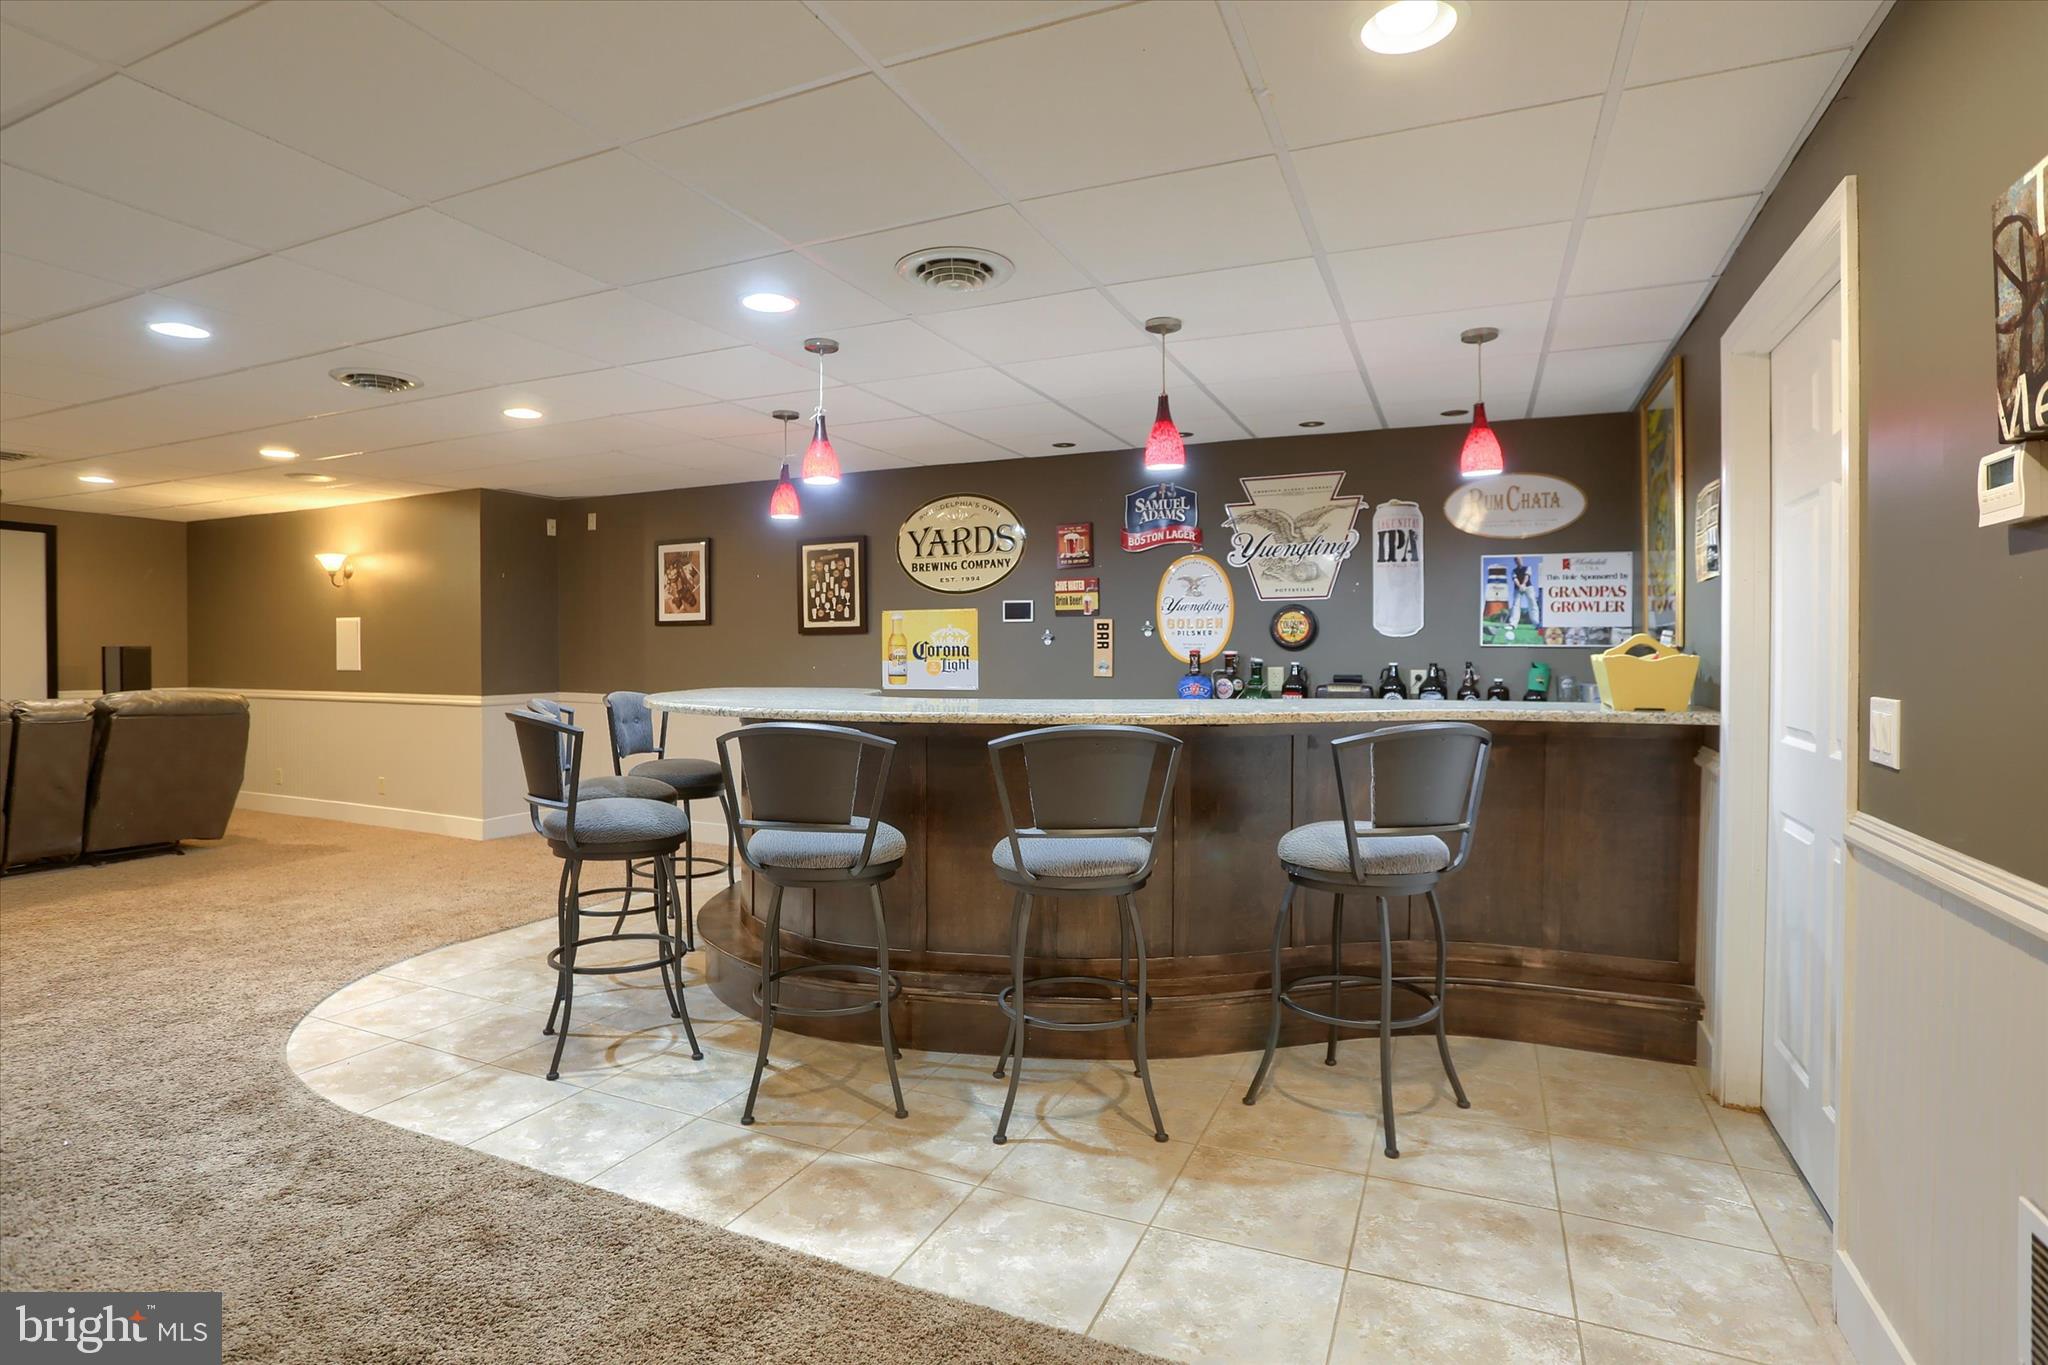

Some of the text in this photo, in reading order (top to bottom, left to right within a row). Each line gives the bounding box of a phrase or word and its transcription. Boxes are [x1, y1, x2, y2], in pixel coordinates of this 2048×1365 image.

[982, 505, 1000, 518] OWN
[1135, 496, 1190, 512] SAMUEL
[1139, 509, 1186, 524] ADAMS
[907, 524, 1017, 558] YARDS
[1128, 530, 1196, 546] BOSTON LAGER
[1377, 529, 1419, 563] IPA
[1229, 532, 1351, 564] Yuengling
[911, 558, 1011, 573] BREWING COMPANY
[1548, 585, 1627, 598] GRANDPAS
[1162, 596, 1226, 616] Yuengling
[1550, 600, 1626, 613] GROWLER
[1167, 617, 1224, 630] GOLDEN
[1096, 623, 1110, 649] BAR
[912, 641, 970, 662] Corona
[941, 658, 970, 673] Light
